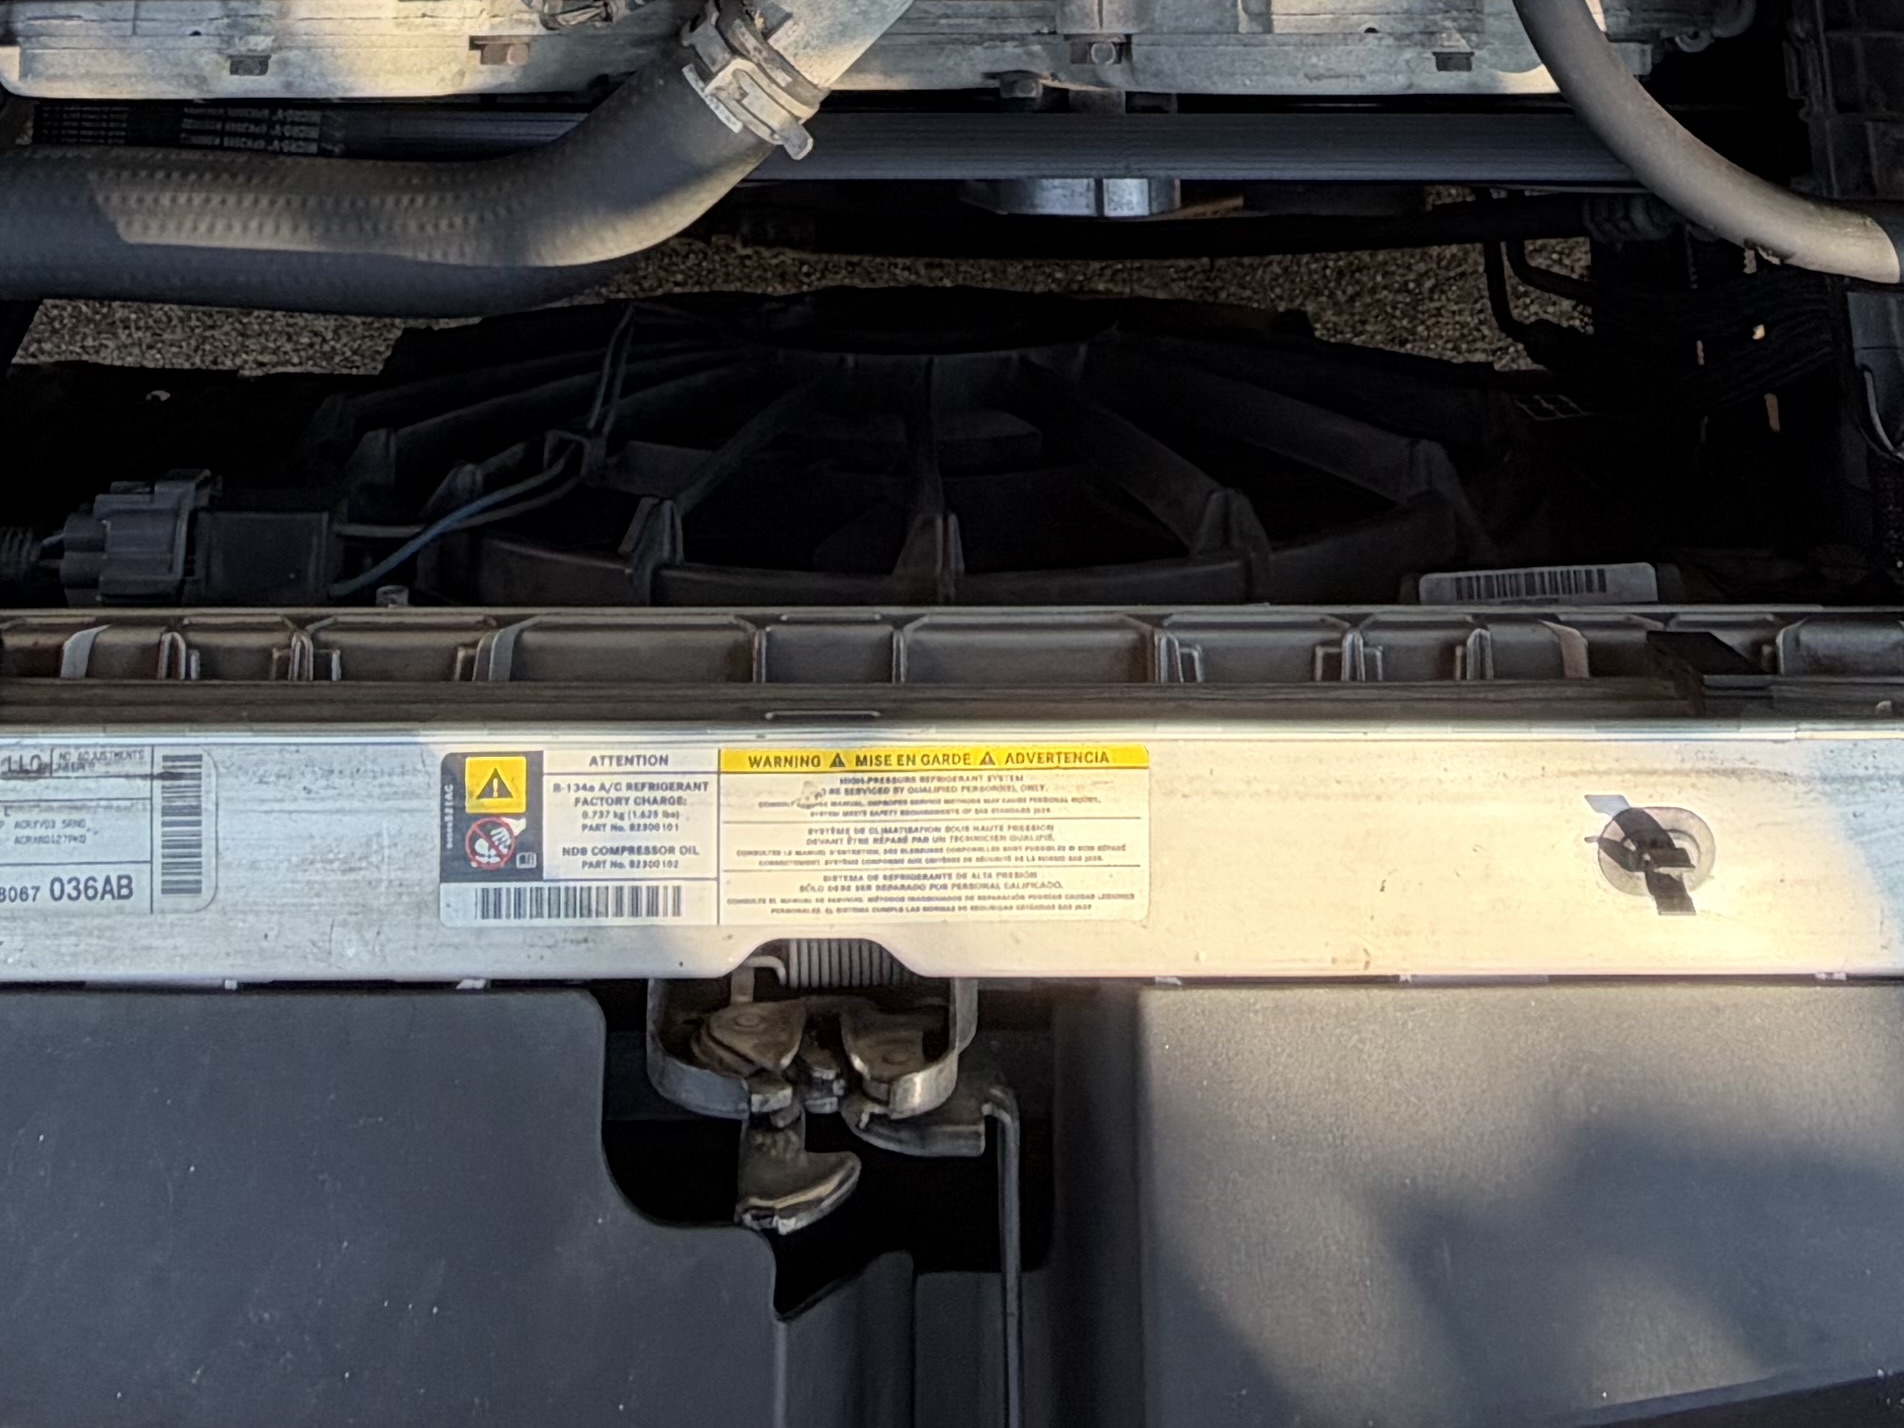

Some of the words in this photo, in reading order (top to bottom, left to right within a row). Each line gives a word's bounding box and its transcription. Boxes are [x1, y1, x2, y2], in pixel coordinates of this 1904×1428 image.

[589, 754, 669, 767] ATTENTION
[748, 755, 821, 768] WARNING
[855, 754, 892, 767] MISE
[897, 754, 917, 766] EN
[920, 753, 971, 766] GARDE
[1004, 751, 1110, 764] ADVERTENCIA
[553, 782, 595, 793] R-134a
[598, 782, 623, 794] A/C
[626, 781, 709, 792] REFRIGERANT
[574, 796, 631, 807] FACTORY
[634, 796, 688, 806] CHARGE:
[581, 823, 607, 832] PART
[591, 845, 675, 856] COMPRESSOR
[679, 845, 700, 856] OIL
[581, 860, 607, 869] PART
[49, 874, 134, 901] 036AB
